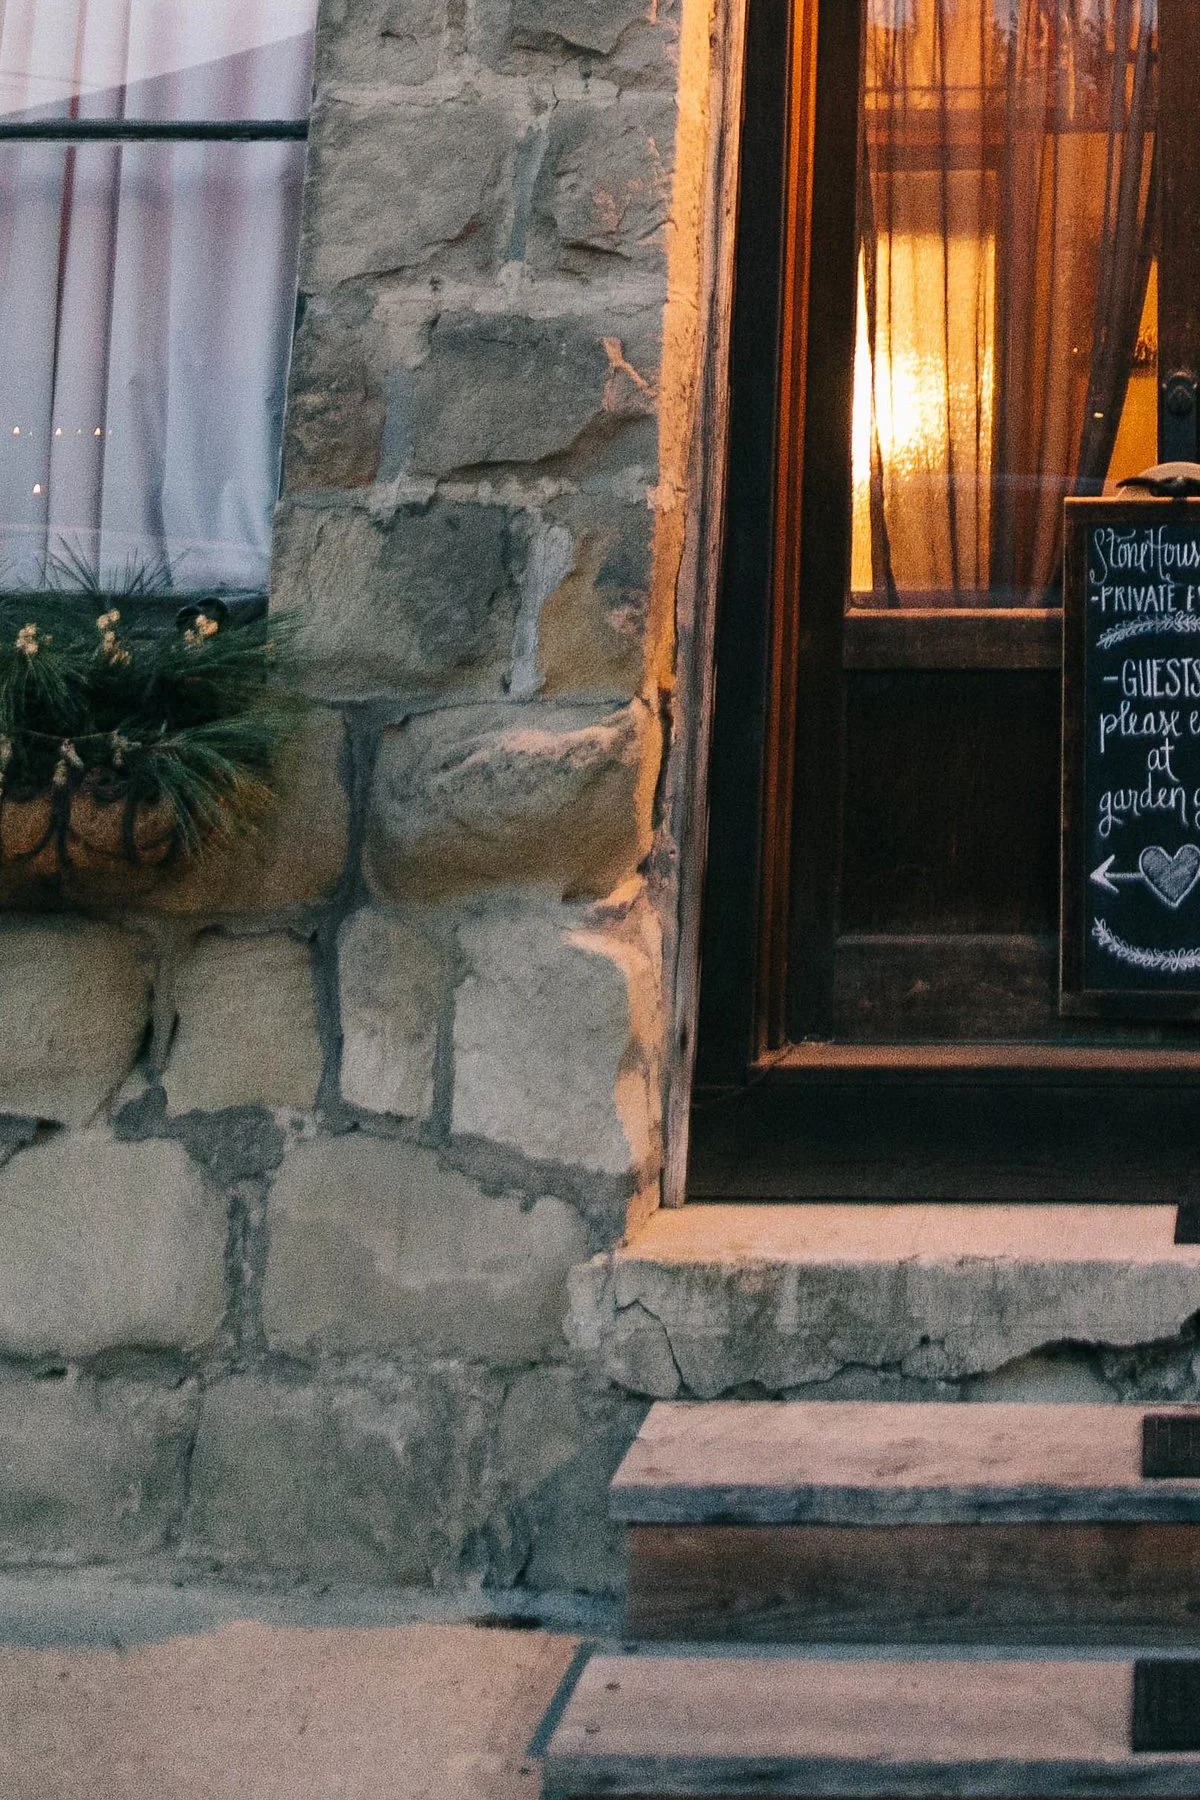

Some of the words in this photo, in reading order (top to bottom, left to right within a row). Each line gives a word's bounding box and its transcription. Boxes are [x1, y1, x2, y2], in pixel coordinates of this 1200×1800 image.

[1099, 700, 1183, 754] please
[1147, 737, 1181, 783] at
[1098, 770, 1190, 838] garden
